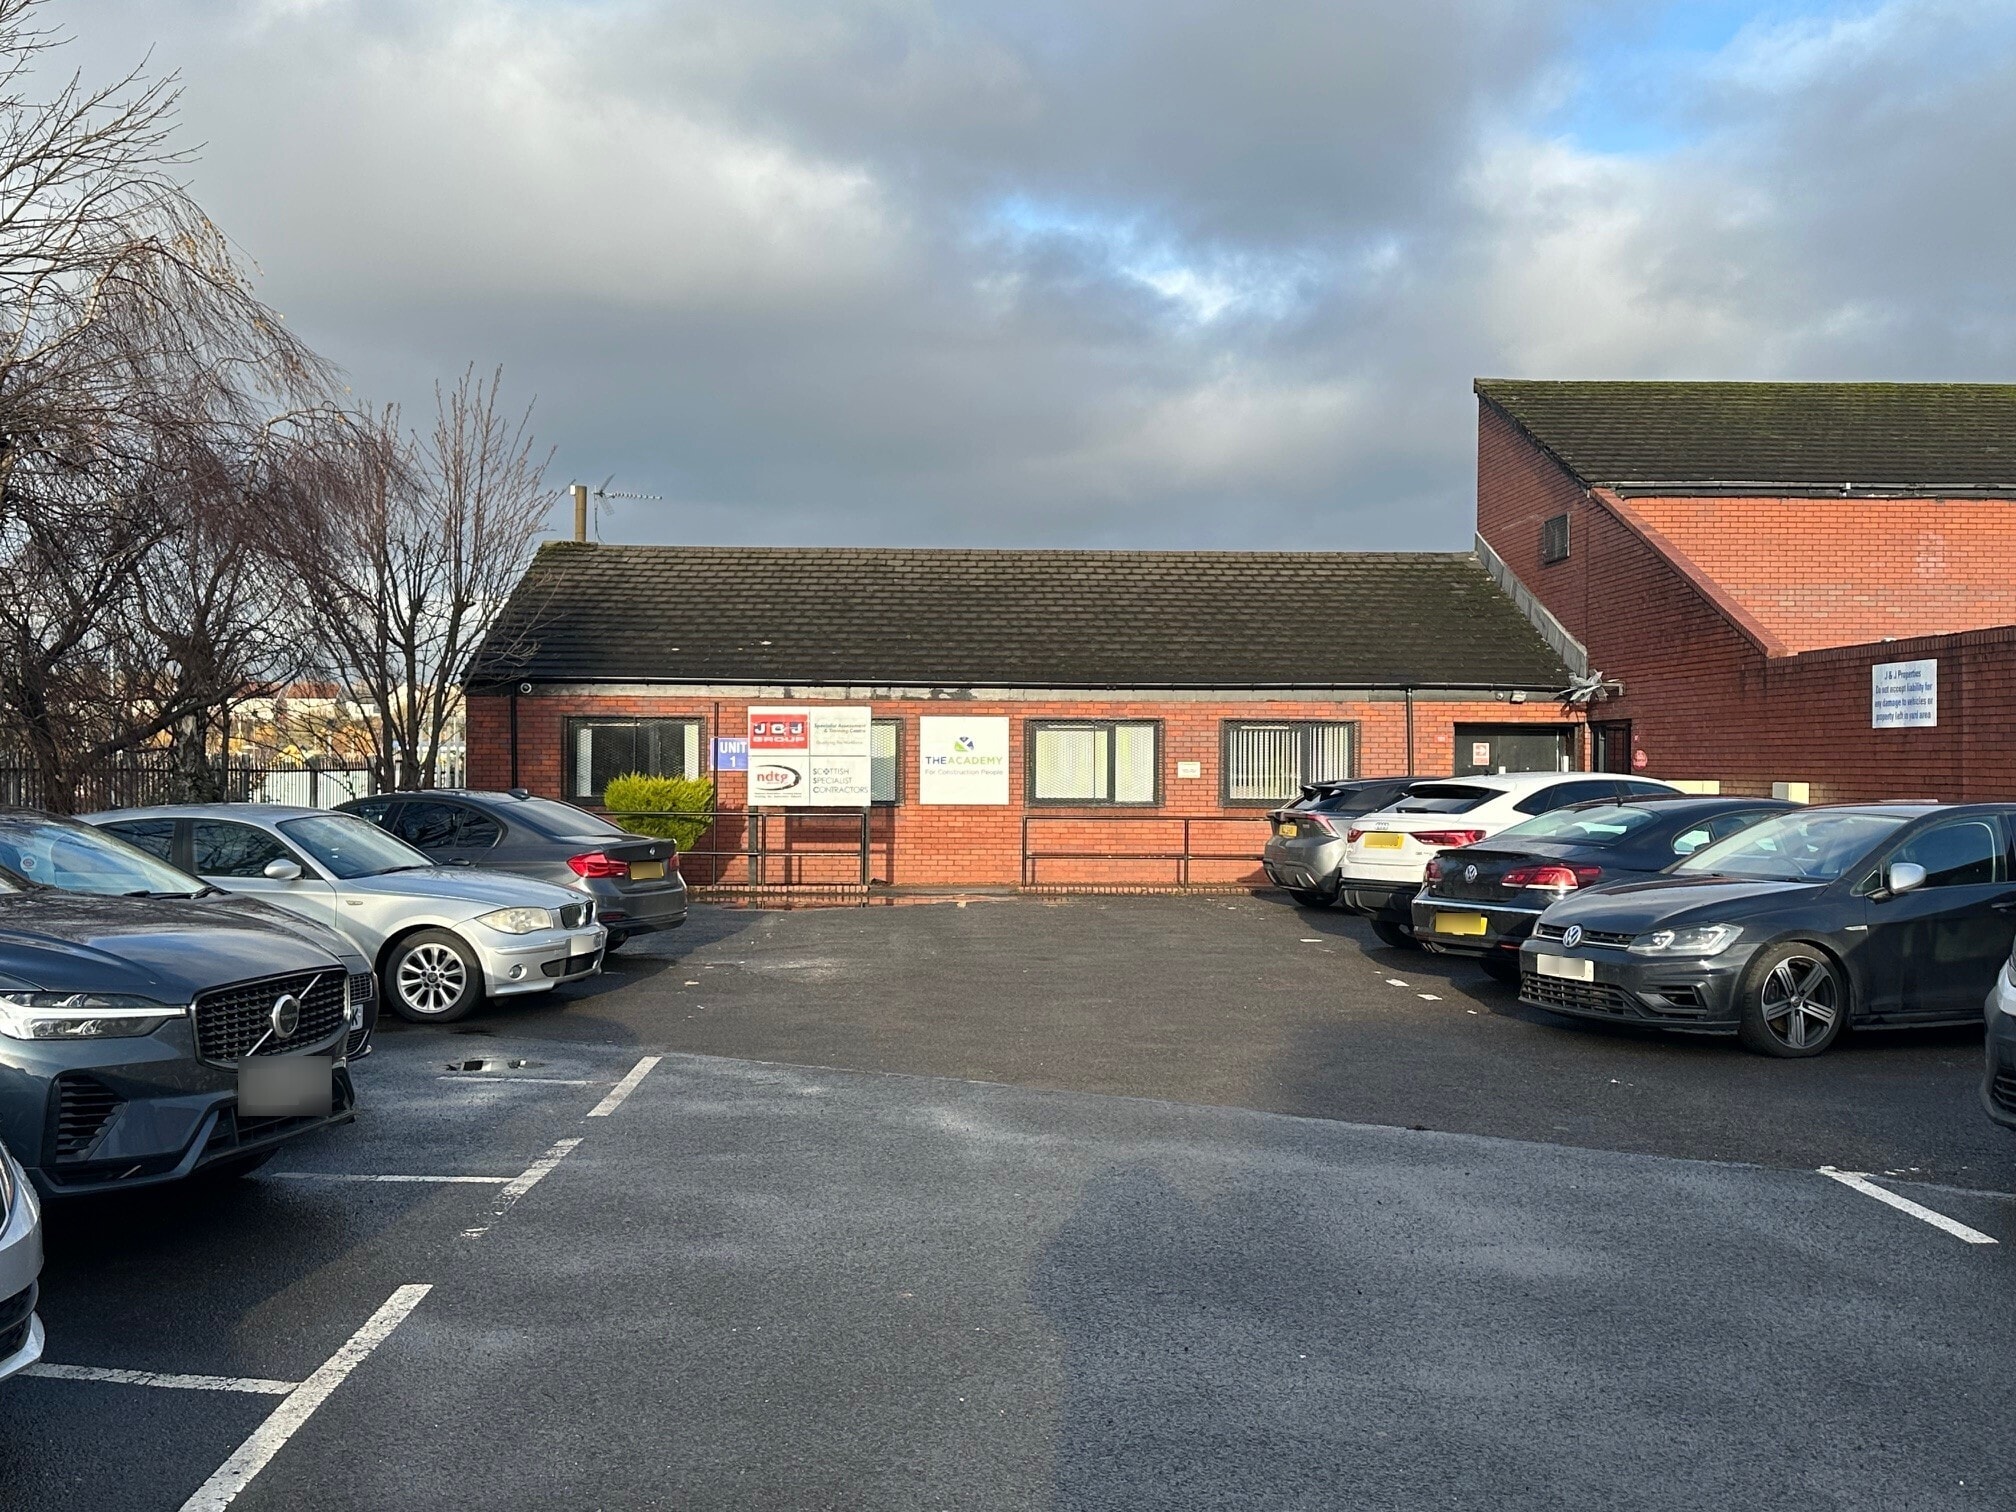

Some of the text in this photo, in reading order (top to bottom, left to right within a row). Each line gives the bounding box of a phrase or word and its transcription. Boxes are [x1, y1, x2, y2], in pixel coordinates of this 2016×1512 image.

[1898, 670, 1921, 680] Properties
[1907, 683, 1924, 693] liability
[1882, 698, 1901, 708] damage
[1907, 697, 1926, 705] vehicles
[719, 741, 747, 754] UNIT
[730, 756, 736, 767] 1
[757, 770, 788, 784] ndtg
[981, 769, 1004, 777] People
[813, 786, 869, 794] CONTRACTORS
